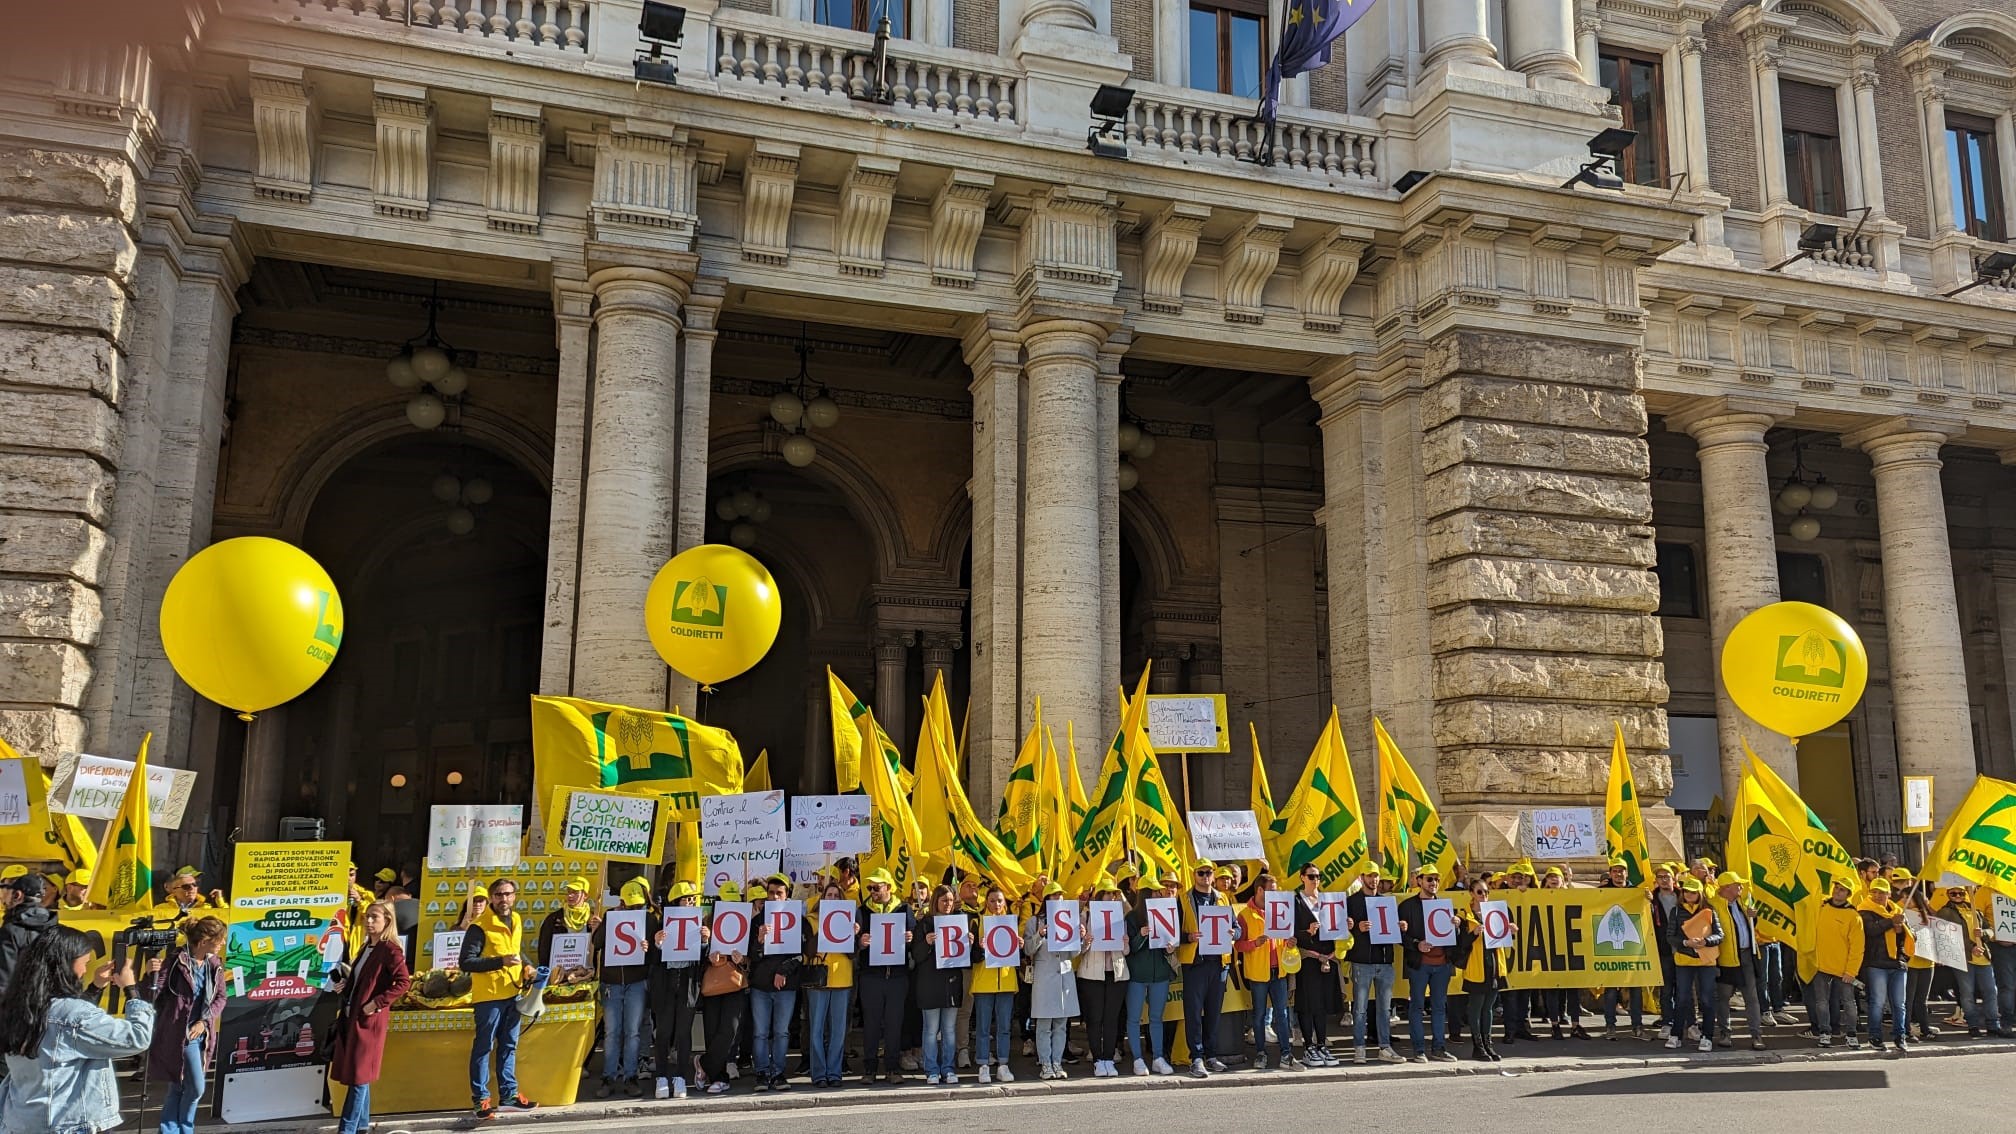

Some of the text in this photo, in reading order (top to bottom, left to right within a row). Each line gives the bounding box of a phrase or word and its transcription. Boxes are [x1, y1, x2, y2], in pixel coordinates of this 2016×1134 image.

[670, 625, 723, 640] COLDIRETTI
[1772, 685, 1841, 704] COLDIRETTI
[79, 765, 133, 778] DIFENDIAM
[576, 794, 624, 814] BUON
[570, 810, 651, 833] COMPLEANNO
[569, 824, 613, 839] DIETA
[1535, 824, 1578, 839] NUOVA
[567, 838, 648, 855] MEDITERRANEA
[1536, 836, 1582, 850] PAZZA
[240, 896, 339, 907] DA CHE PARTE STAI?
[274, 911, 301, 919] CIBO
[260, 919, 317, 929] NATURALE
[1593, 960, 1652, 972] COLDIRETTI
[268, 979, 294, 988] CIBO
[249, 986, 313, 998] ARTIFICIALE
